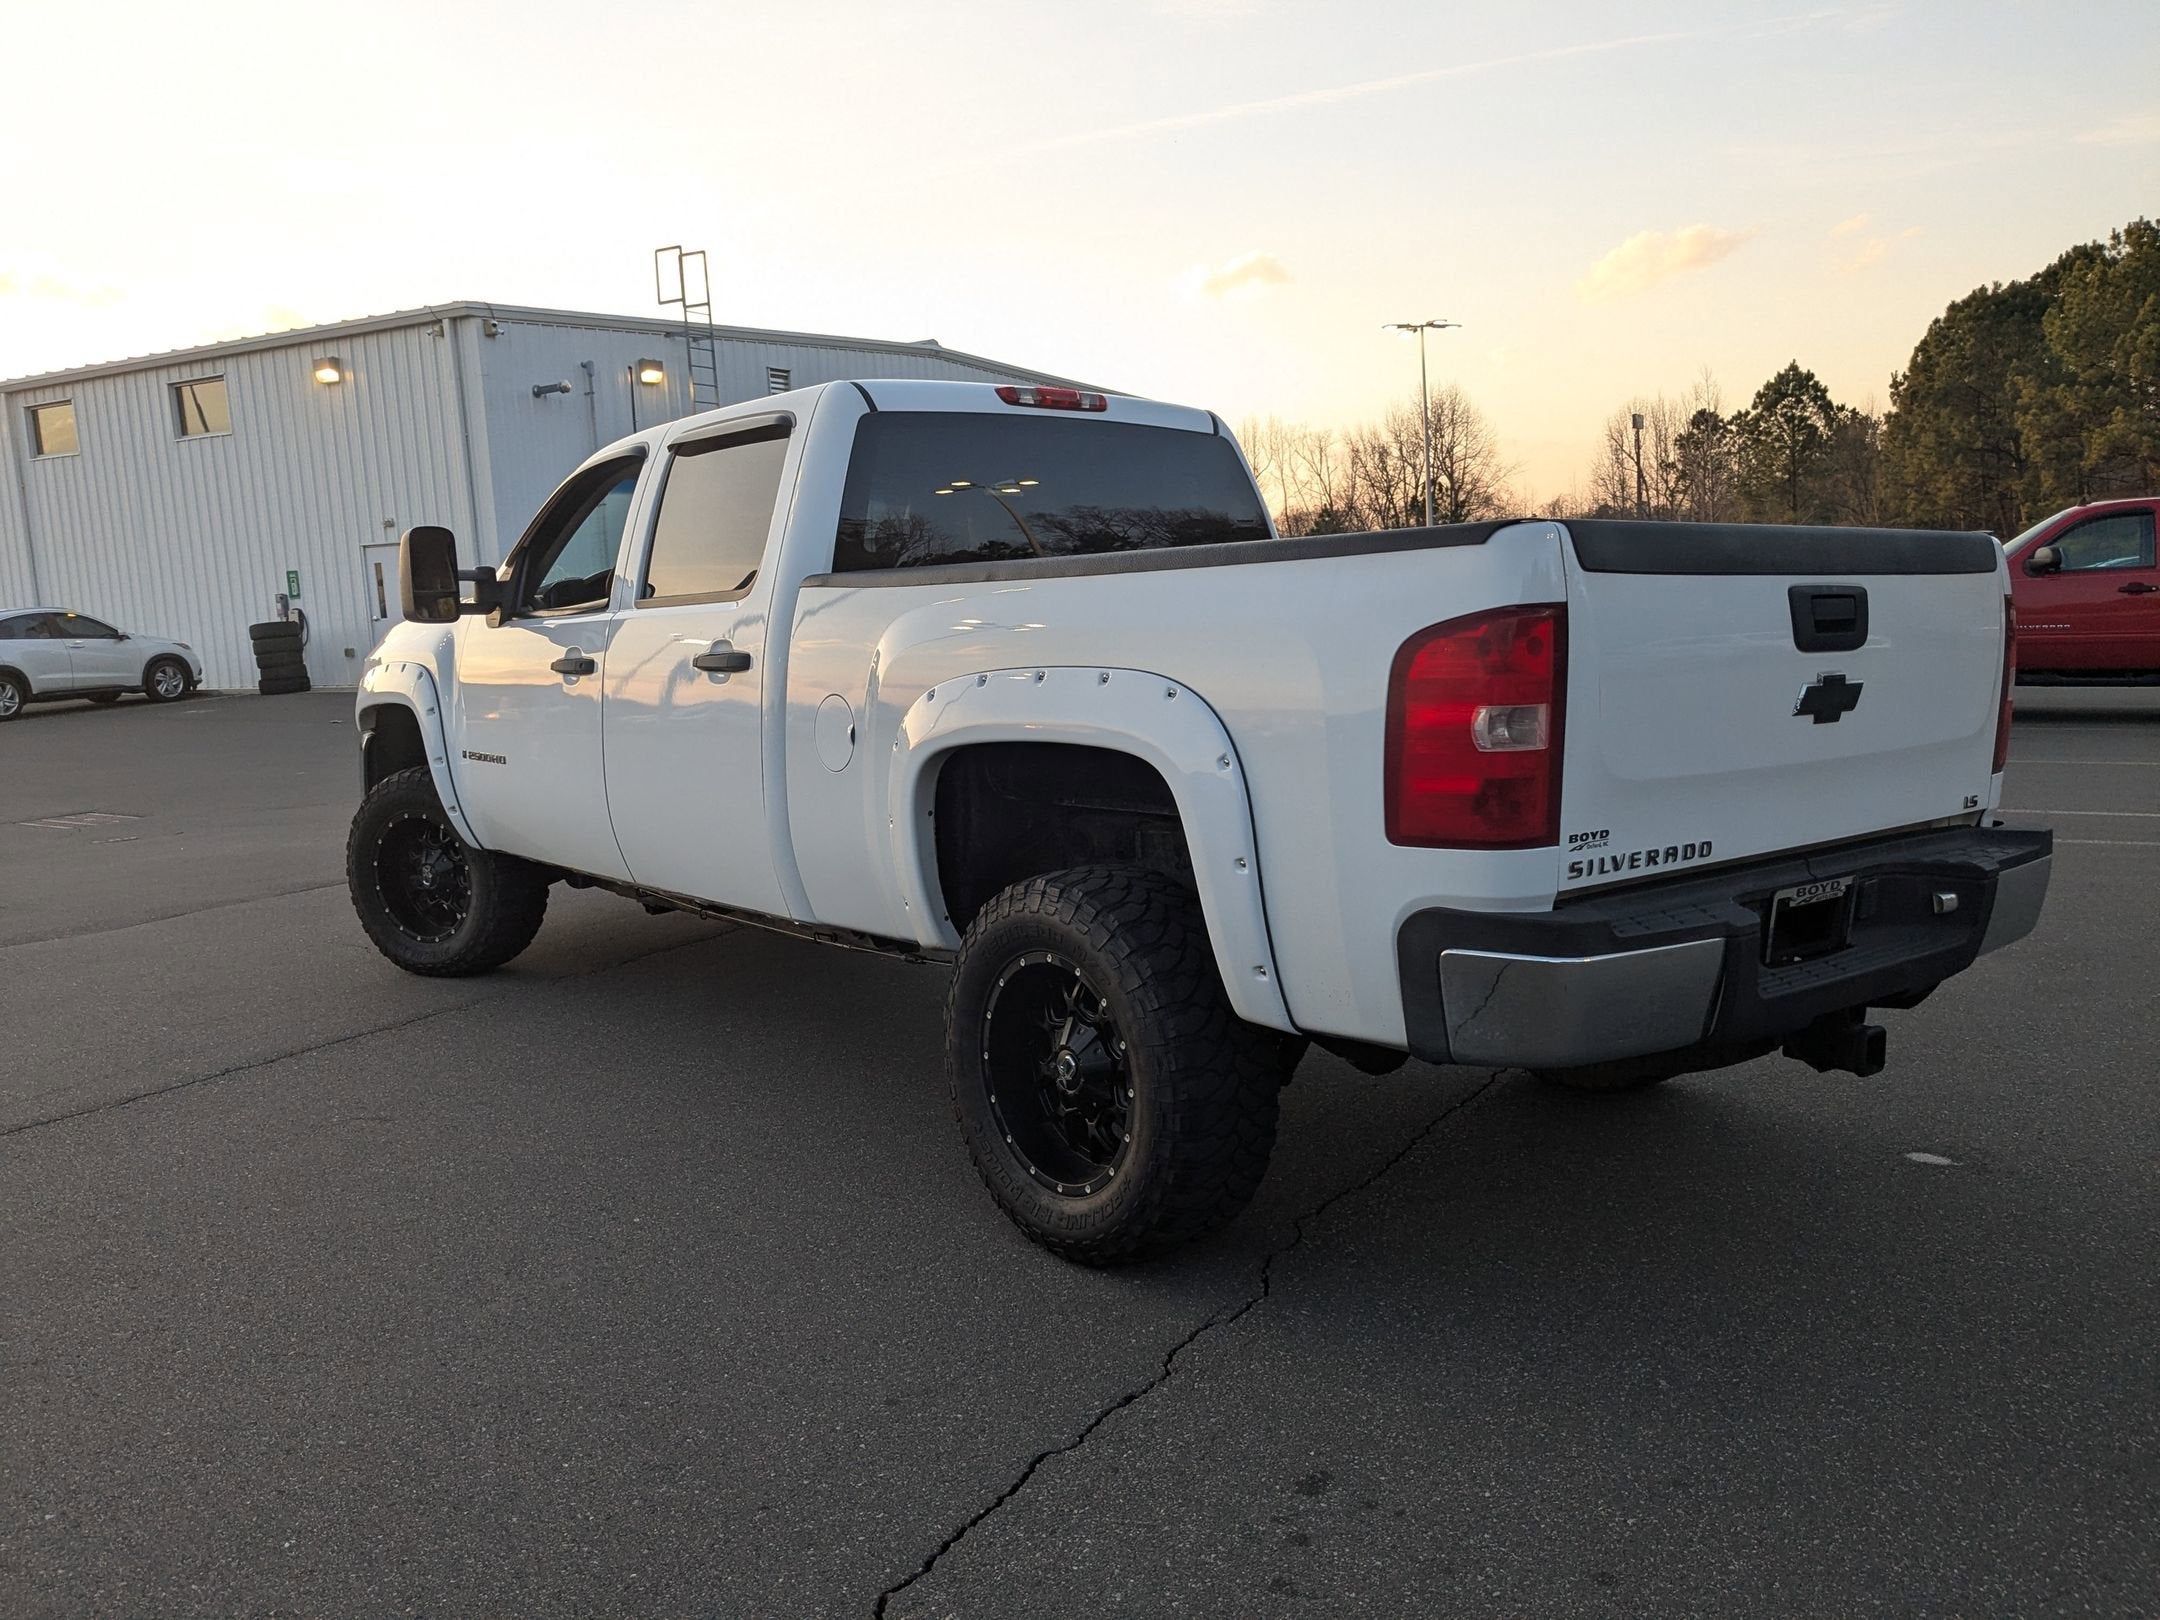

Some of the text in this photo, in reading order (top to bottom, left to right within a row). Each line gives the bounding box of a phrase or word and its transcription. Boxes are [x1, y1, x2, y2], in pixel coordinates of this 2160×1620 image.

[1568, 829, 1610, 844] BOYD
[1567, 841, 1713, 880] SILVERADO
[1796, 880, 1841, 898] BOYD
